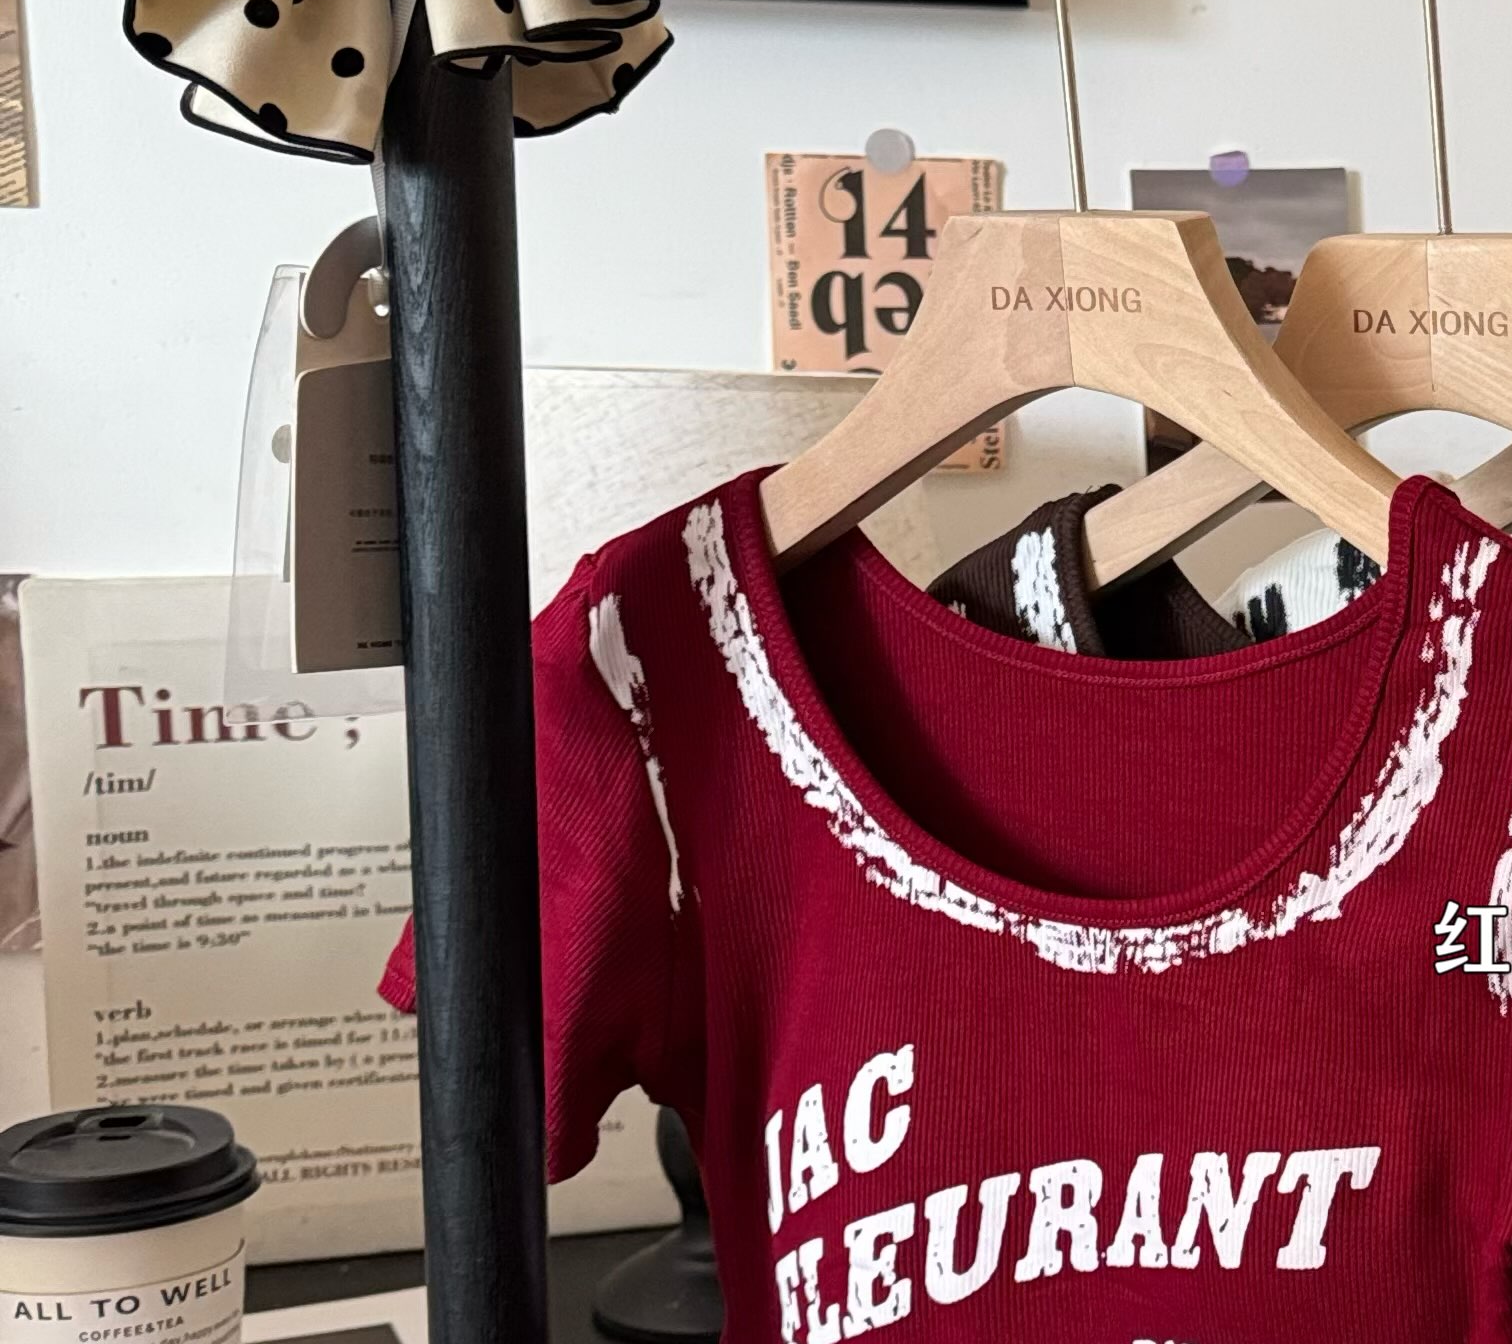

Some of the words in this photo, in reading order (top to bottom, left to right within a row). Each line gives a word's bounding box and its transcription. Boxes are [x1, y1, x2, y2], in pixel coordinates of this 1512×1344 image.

[990, 286, 1034, 312] DA
[1045, 285, 1143, 313] XIONG
[1353, 308, 1397, 335] DA
[1408, 308, 1510, 338] XIONG
[79, 686, 318, 750] Time
[83, 768, 157, 796] /tim/
[86, 830, 150, 846] noun
[94, 999, 152, 1023] verb
[14, 1301, 73, 1321] ALL
[89, 1295, 140, 1318] TO
[160, 1267, 231, 1307] WELL
[78, 1316, 184, 1343] COFFEE&TEA
